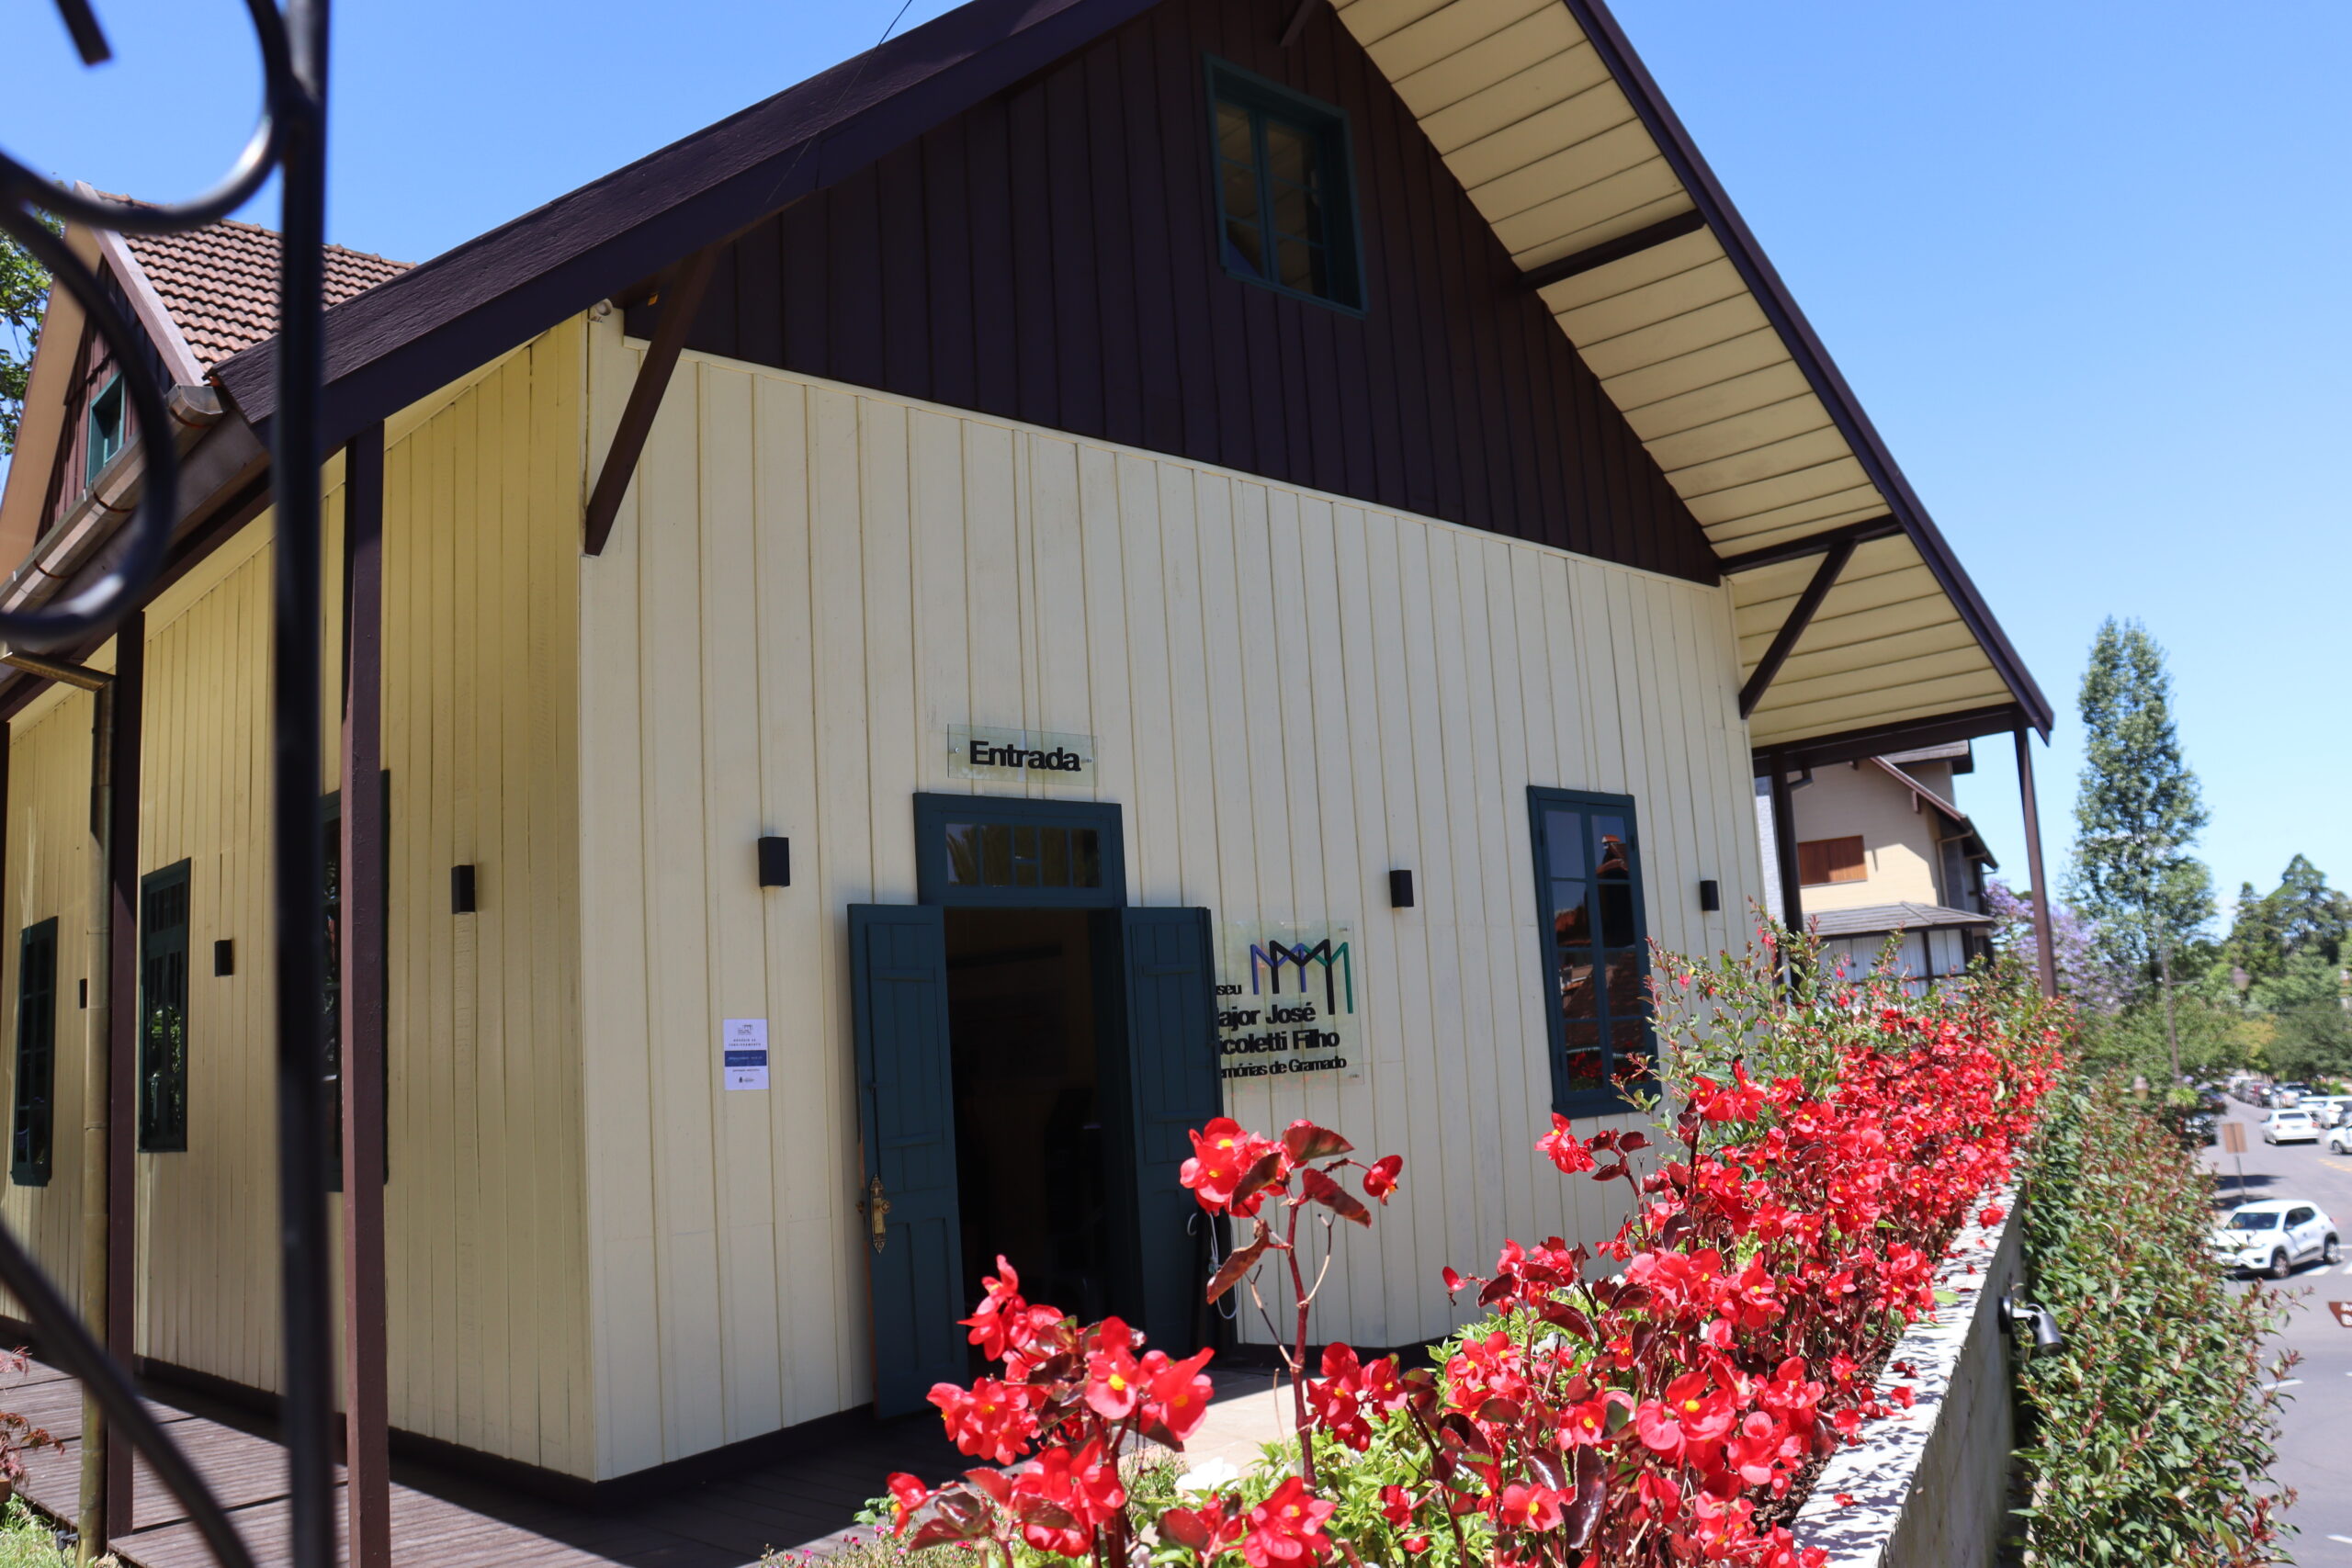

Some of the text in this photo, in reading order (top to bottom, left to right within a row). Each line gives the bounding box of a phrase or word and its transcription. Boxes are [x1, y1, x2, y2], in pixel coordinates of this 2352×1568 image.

[970, 740, 1081, 772] Entrada
[1216, 985, 1242, 995] seu
[1218, 1002, 1316, 1032] ajor José
[1293, 1029, 1340, 1050] Filho
[1270, 1061, 1287, 1075] de
[1288, 1055, 1347, 1073] Gramado
